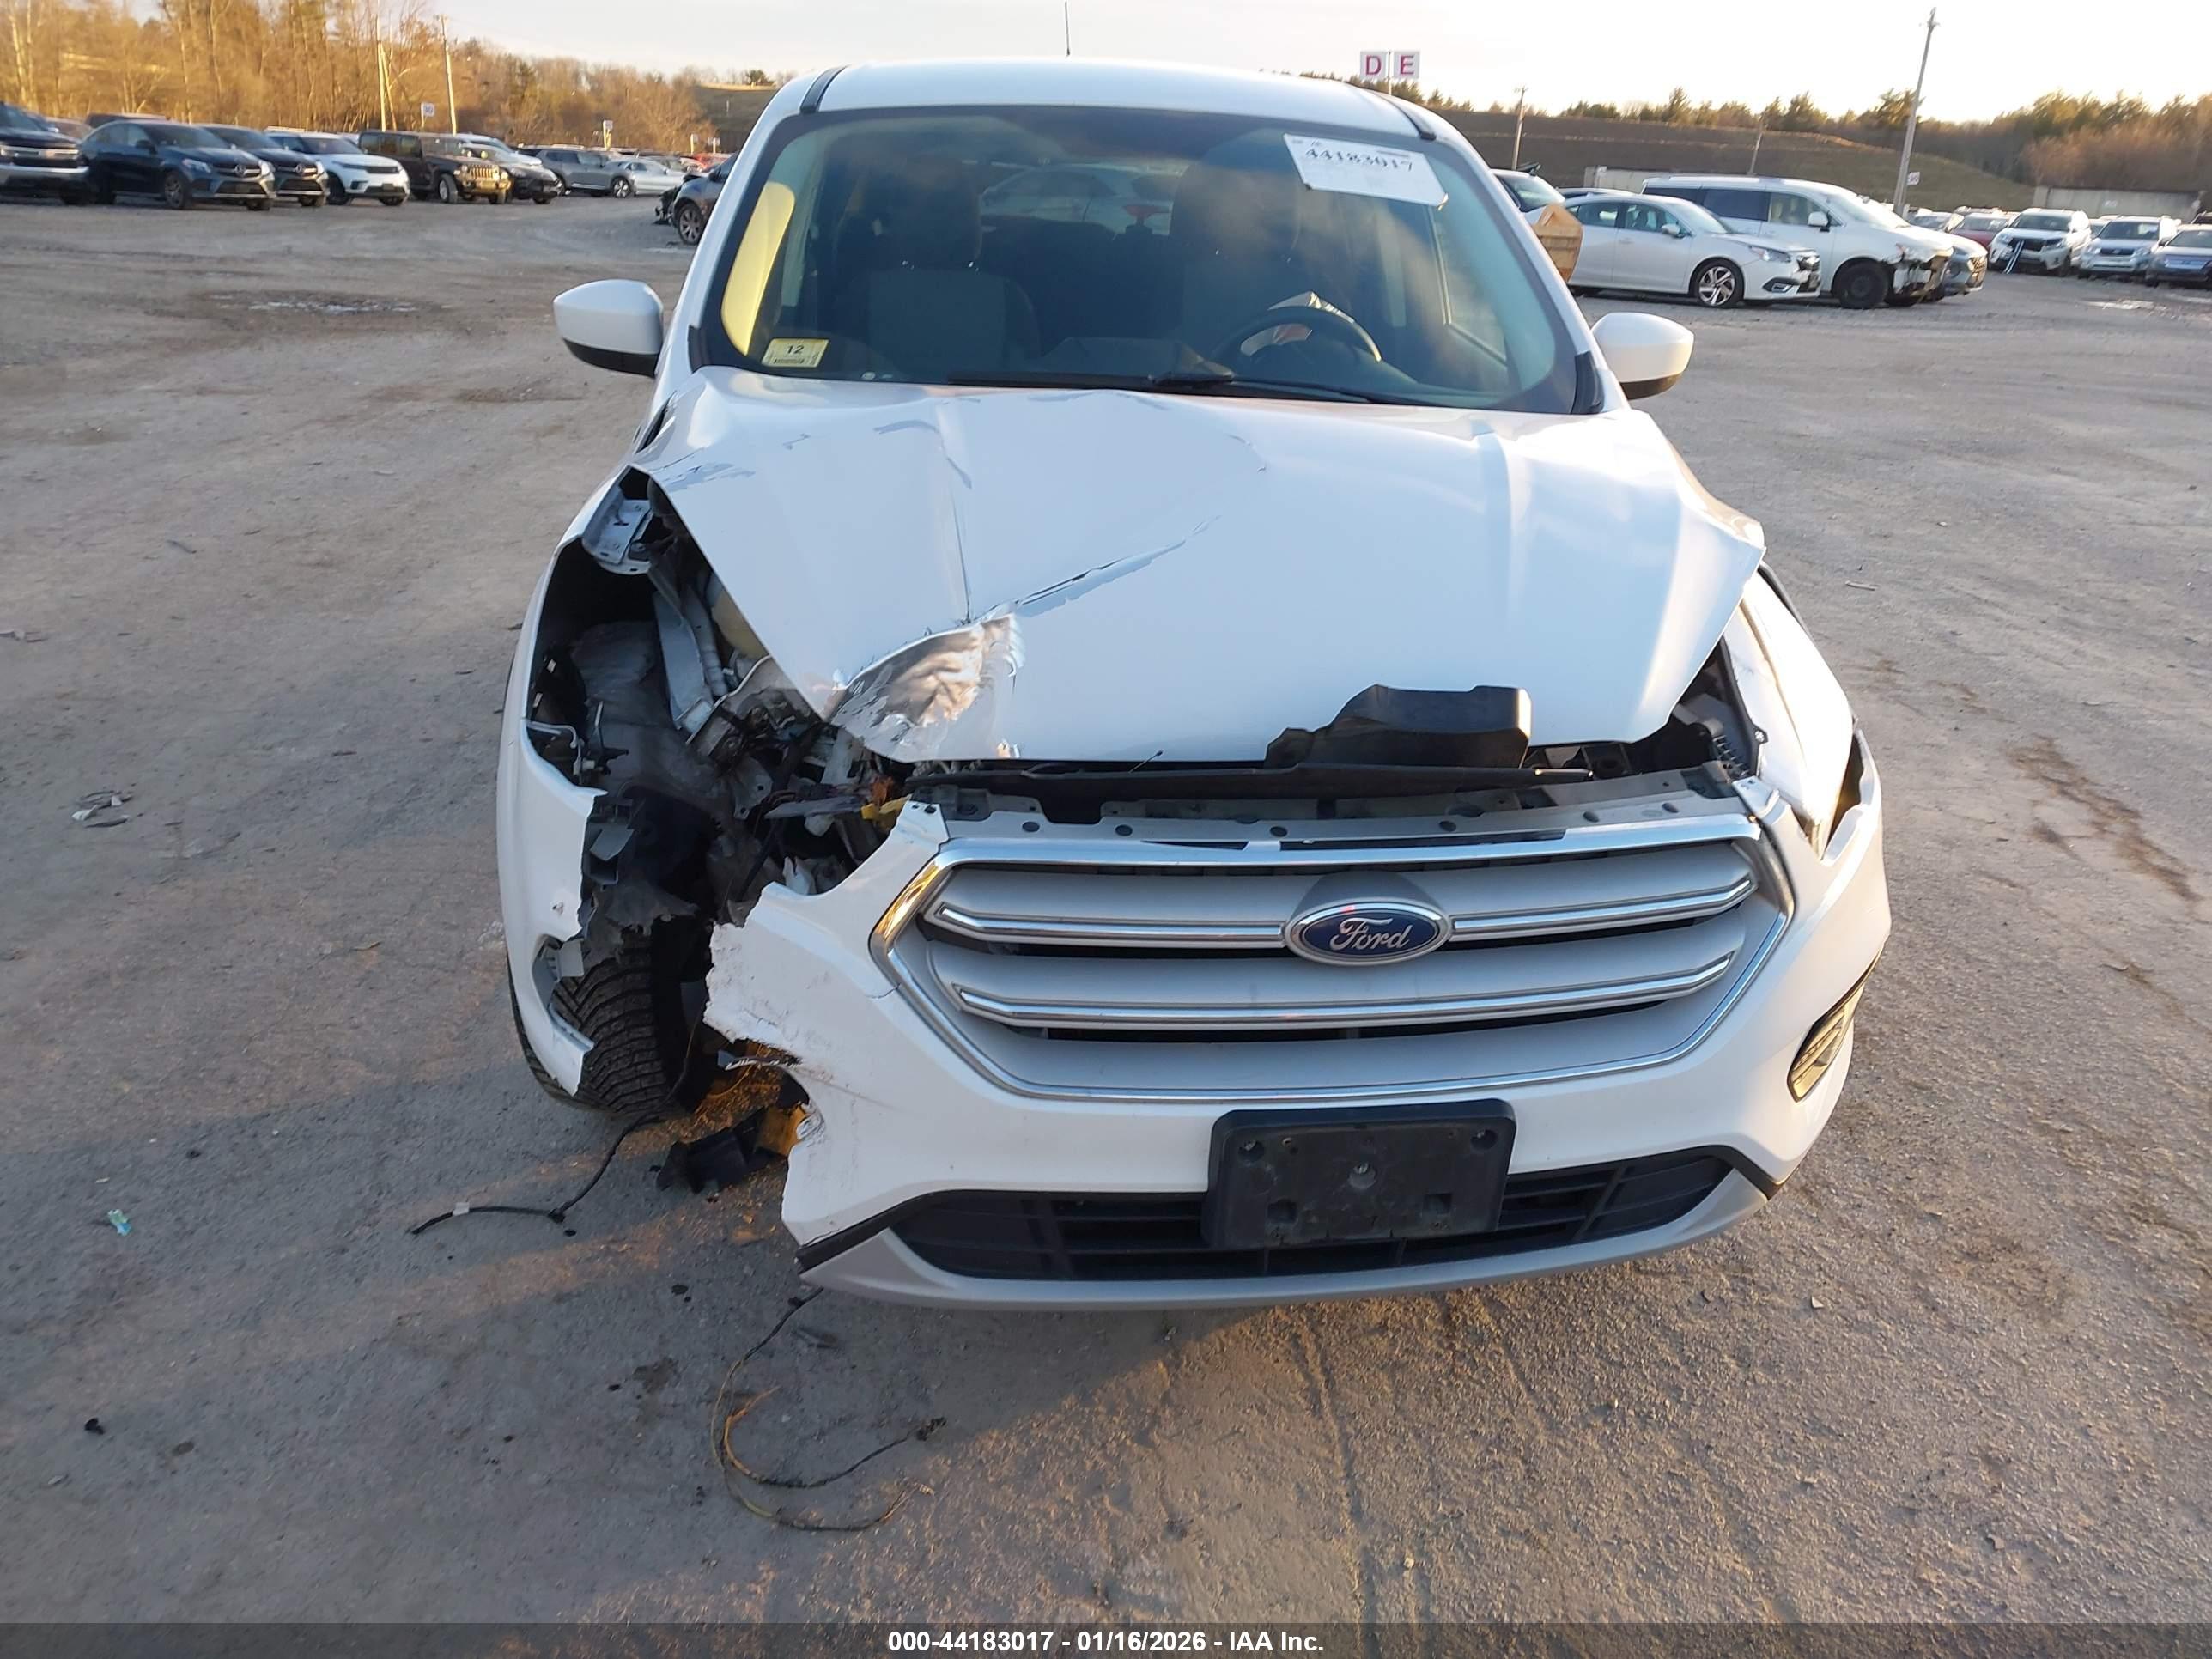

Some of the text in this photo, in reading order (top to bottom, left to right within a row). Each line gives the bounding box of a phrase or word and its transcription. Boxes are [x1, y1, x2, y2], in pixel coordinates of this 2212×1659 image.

[1365, 55, 1382, 76] D
[1400, 55, 1415, 75] E
[787, 344, 805, 355] 12
[1330, 917, 1413, 951] Ford
